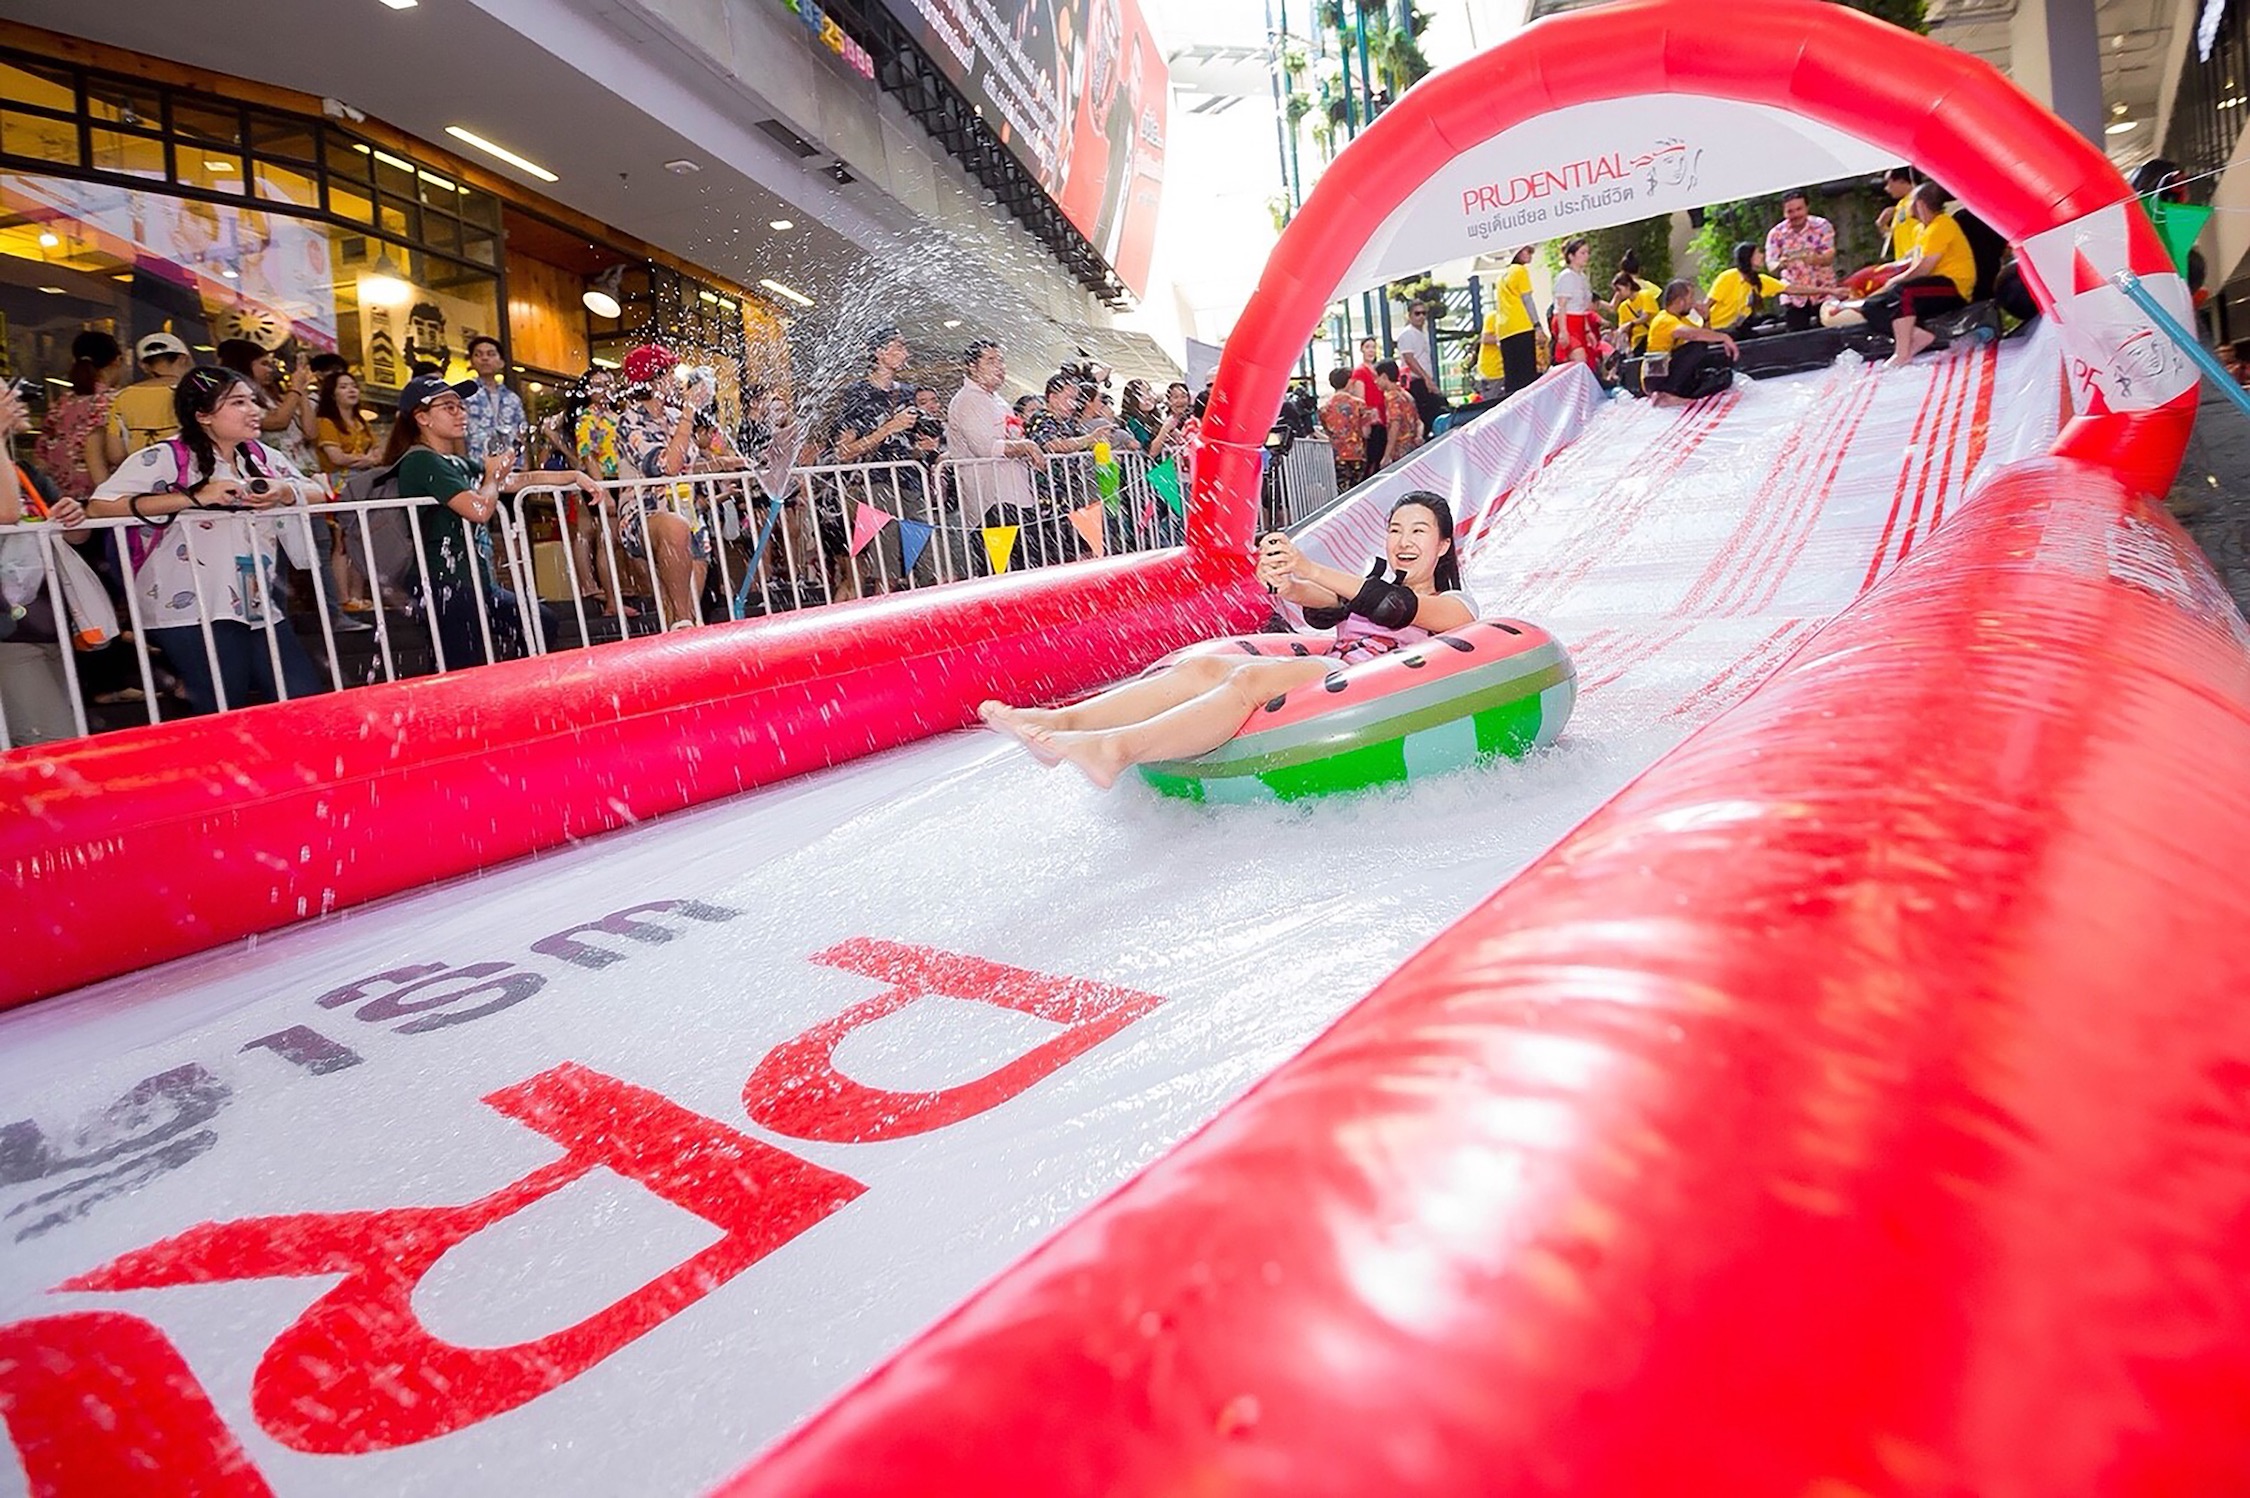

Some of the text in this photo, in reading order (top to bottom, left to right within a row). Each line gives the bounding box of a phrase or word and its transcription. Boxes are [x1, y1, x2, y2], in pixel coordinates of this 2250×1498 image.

[1462, 152, 1631, 216] PRUDENTIAL
[1466, 186, 1634, 240] พรูเด็นเชียล ประกันชีวิต
